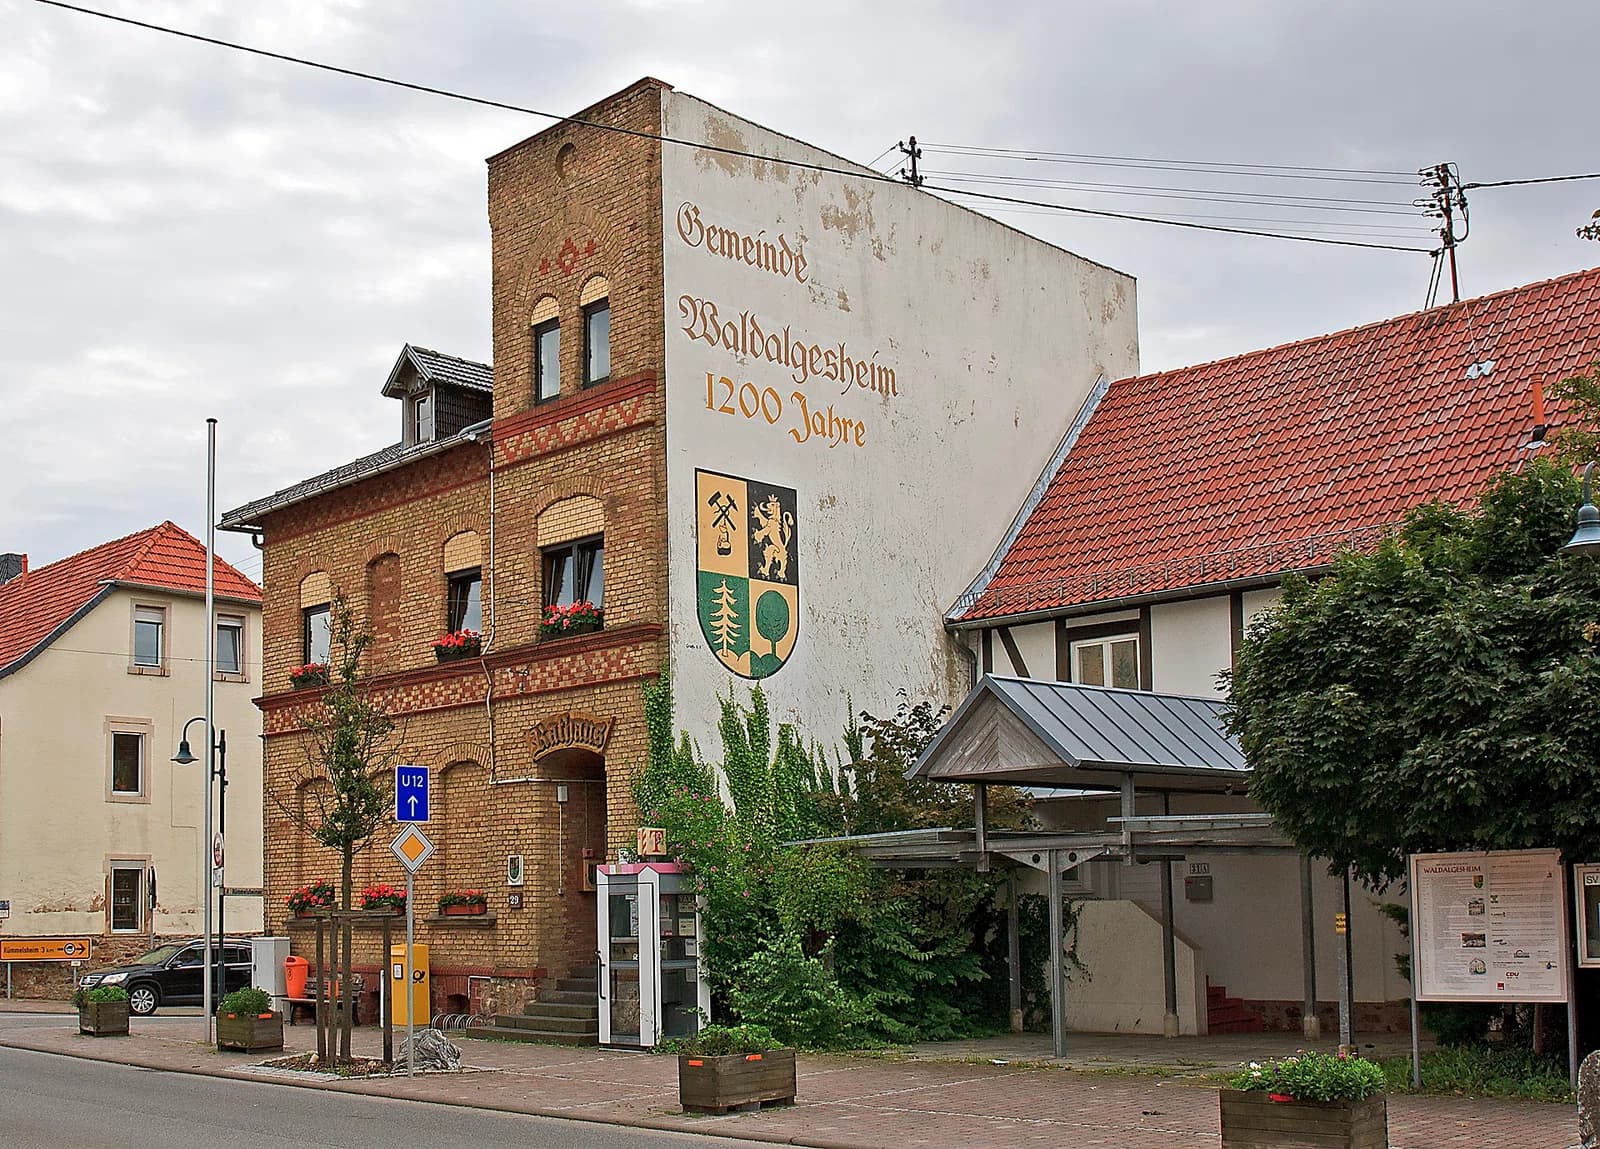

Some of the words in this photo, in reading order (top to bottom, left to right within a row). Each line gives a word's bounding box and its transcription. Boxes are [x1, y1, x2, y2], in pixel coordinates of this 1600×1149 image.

[676, 201, 808, 283] Gemeinde
[679, 295, 898, 396] Waldalgesheim
[705, 372, 783, 424] 1200
[788, 391, 866, 448] Jahre
